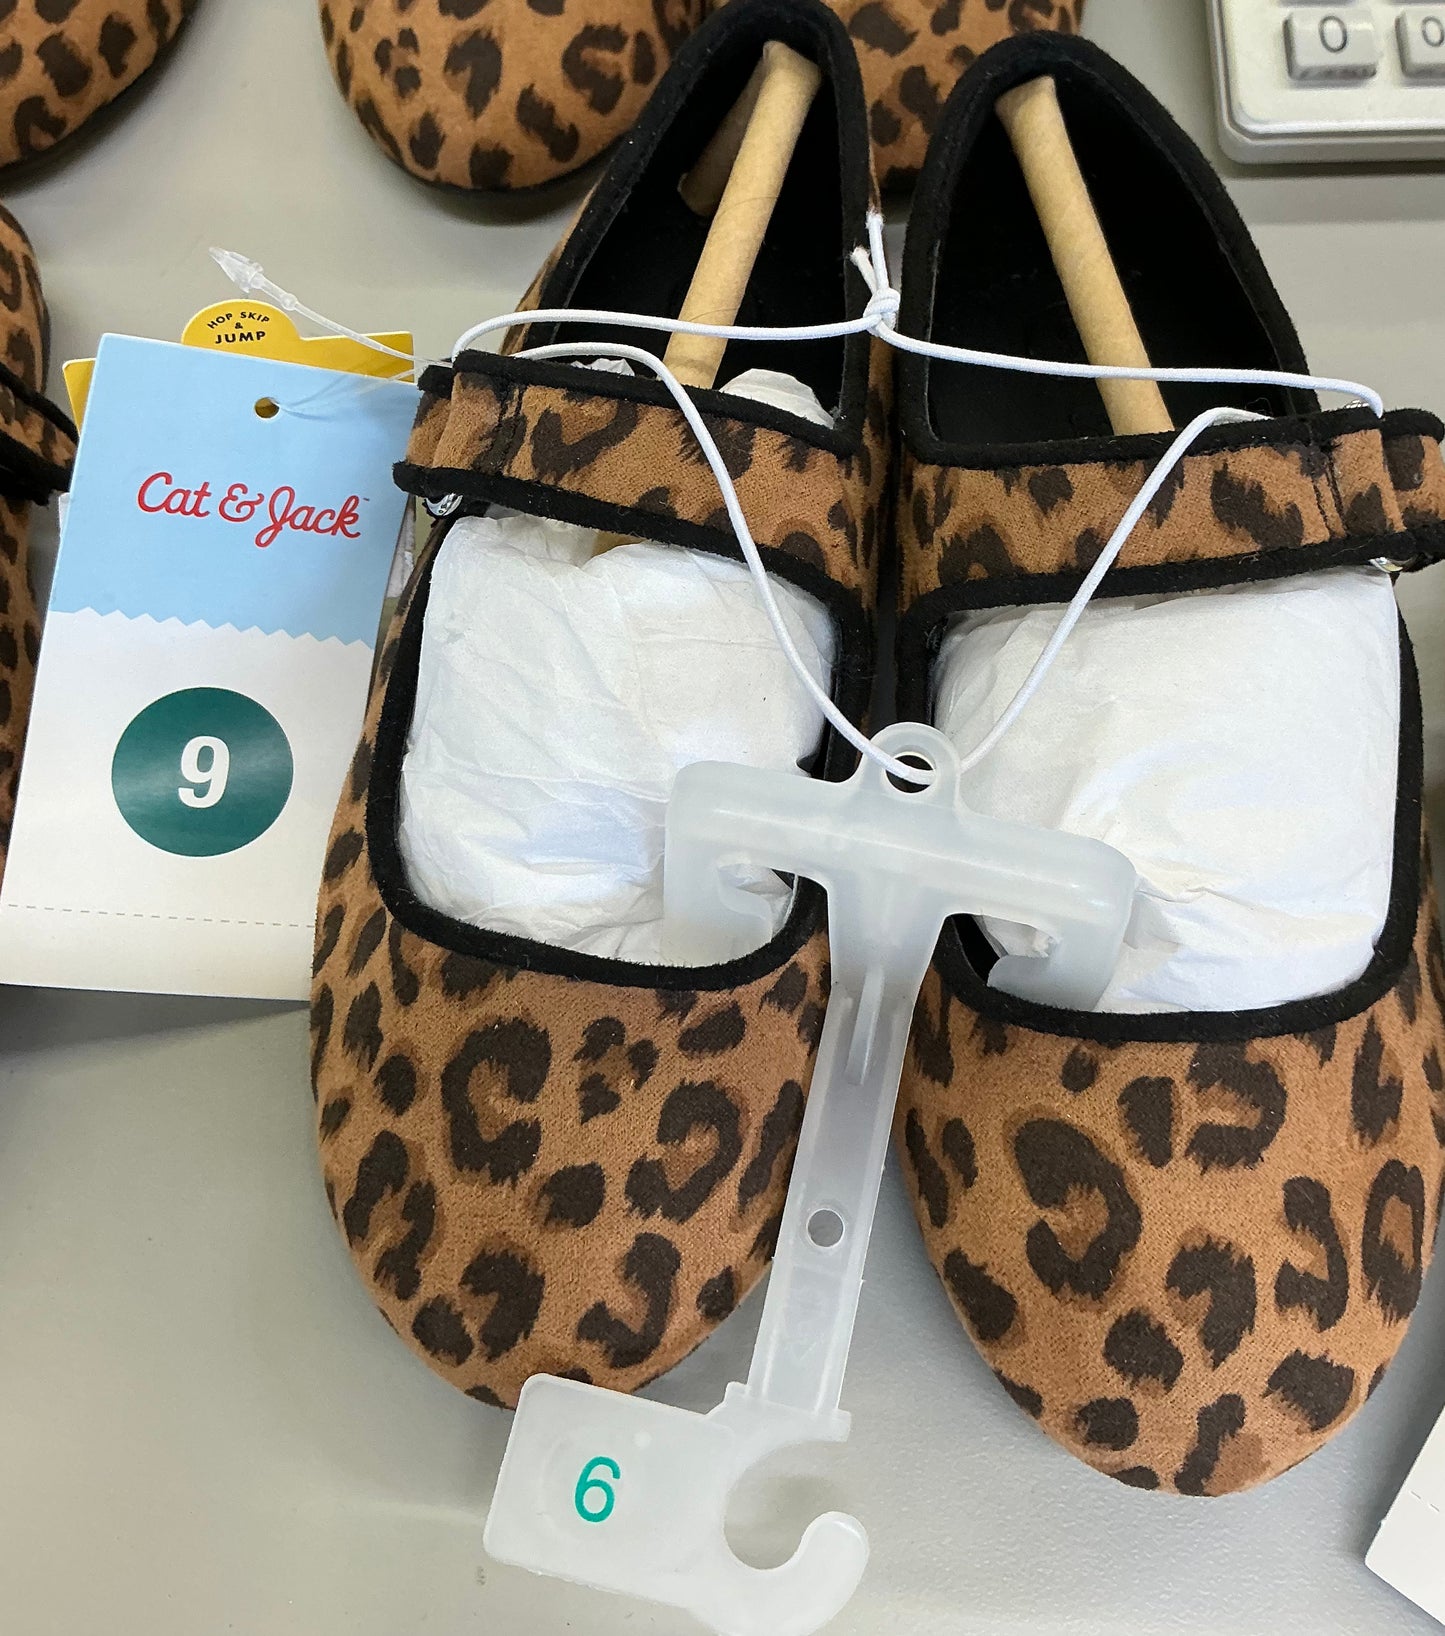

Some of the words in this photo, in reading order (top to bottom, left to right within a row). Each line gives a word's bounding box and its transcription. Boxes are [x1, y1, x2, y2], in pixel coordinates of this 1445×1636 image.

[1318, 15, 1348, 53] 0
[207, 312, 233, 330] HOP
[240, 311, 270, 323] SKIP
[215, 331, 266, 344] JUMP
[137, 471, 212, 518] Cat
[218, 483, 264, 522] &
[254, 486, 361, 548] Jack
[178, 735, 230, 809] 9
